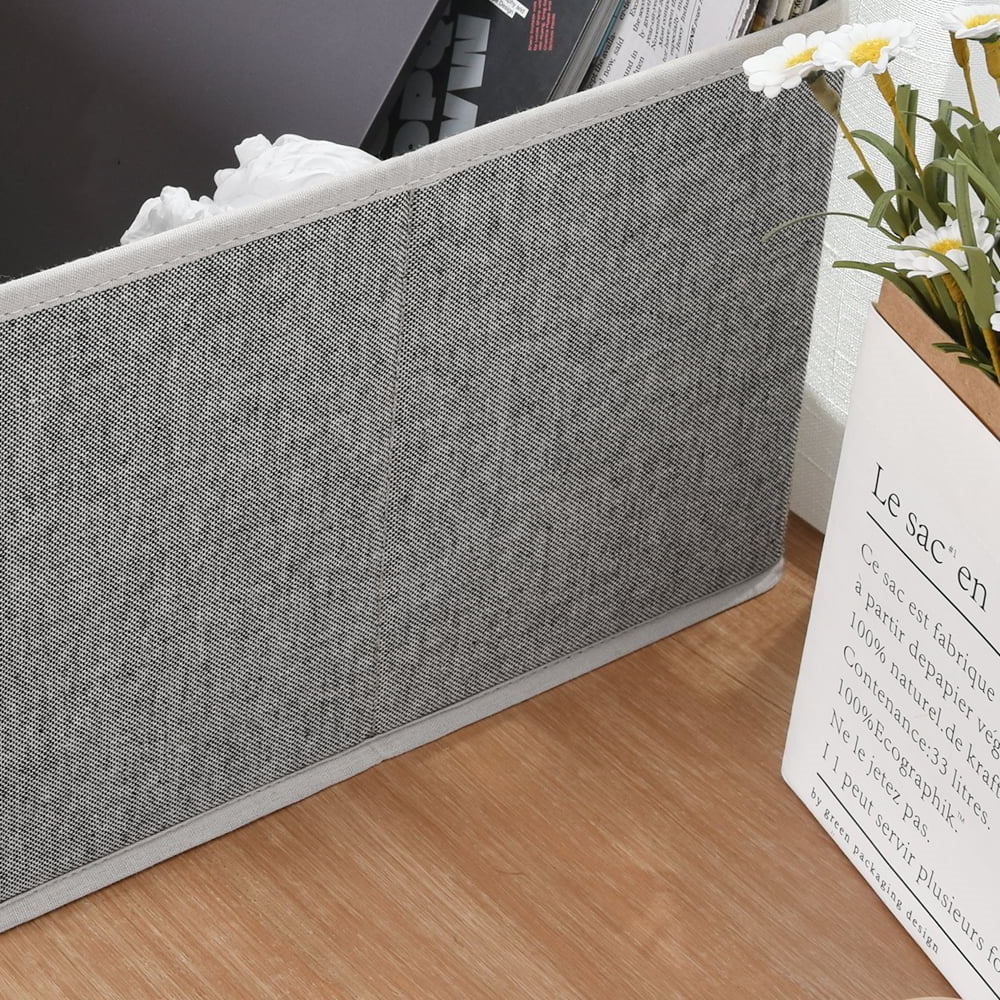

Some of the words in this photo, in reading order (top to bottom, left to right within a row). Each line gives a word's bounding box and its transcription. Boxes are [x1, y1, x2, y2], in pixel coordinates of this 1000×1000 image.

[871, 461, 901, 518] Le
[957, 565, 988, 612] en
[849, 611, 886, 664] 100%
[889, 661, 963, 752] naturel.de
[861, 543, 880, 574] Ce
[883, 572, 905, 603] sac
[908, 600, 930, 631] est
[932, 621, 996, 702] fabrique
[865, 591, 907, 644] partir
[909, 640, 974, 721] depapier
[829, 707, 851, 744] Ne
[852, 735, 866, 762] le
[865, 756, 901, 806] jetez
[902, 801, 931, 844] pas.
[843, 644, 948, 777] Contenance:33
[951, 768, 991, 831] litres.
[810, 786, 823, 808] by
[823, 807, 851, 844] green
[854, 842, 903, 911] packaging
[905, 911, 940, 955] design
[841, 772, 875, 817] peut
[875, 814, 916, 867] servir
[916, 864, 986, 952] plusieurs
